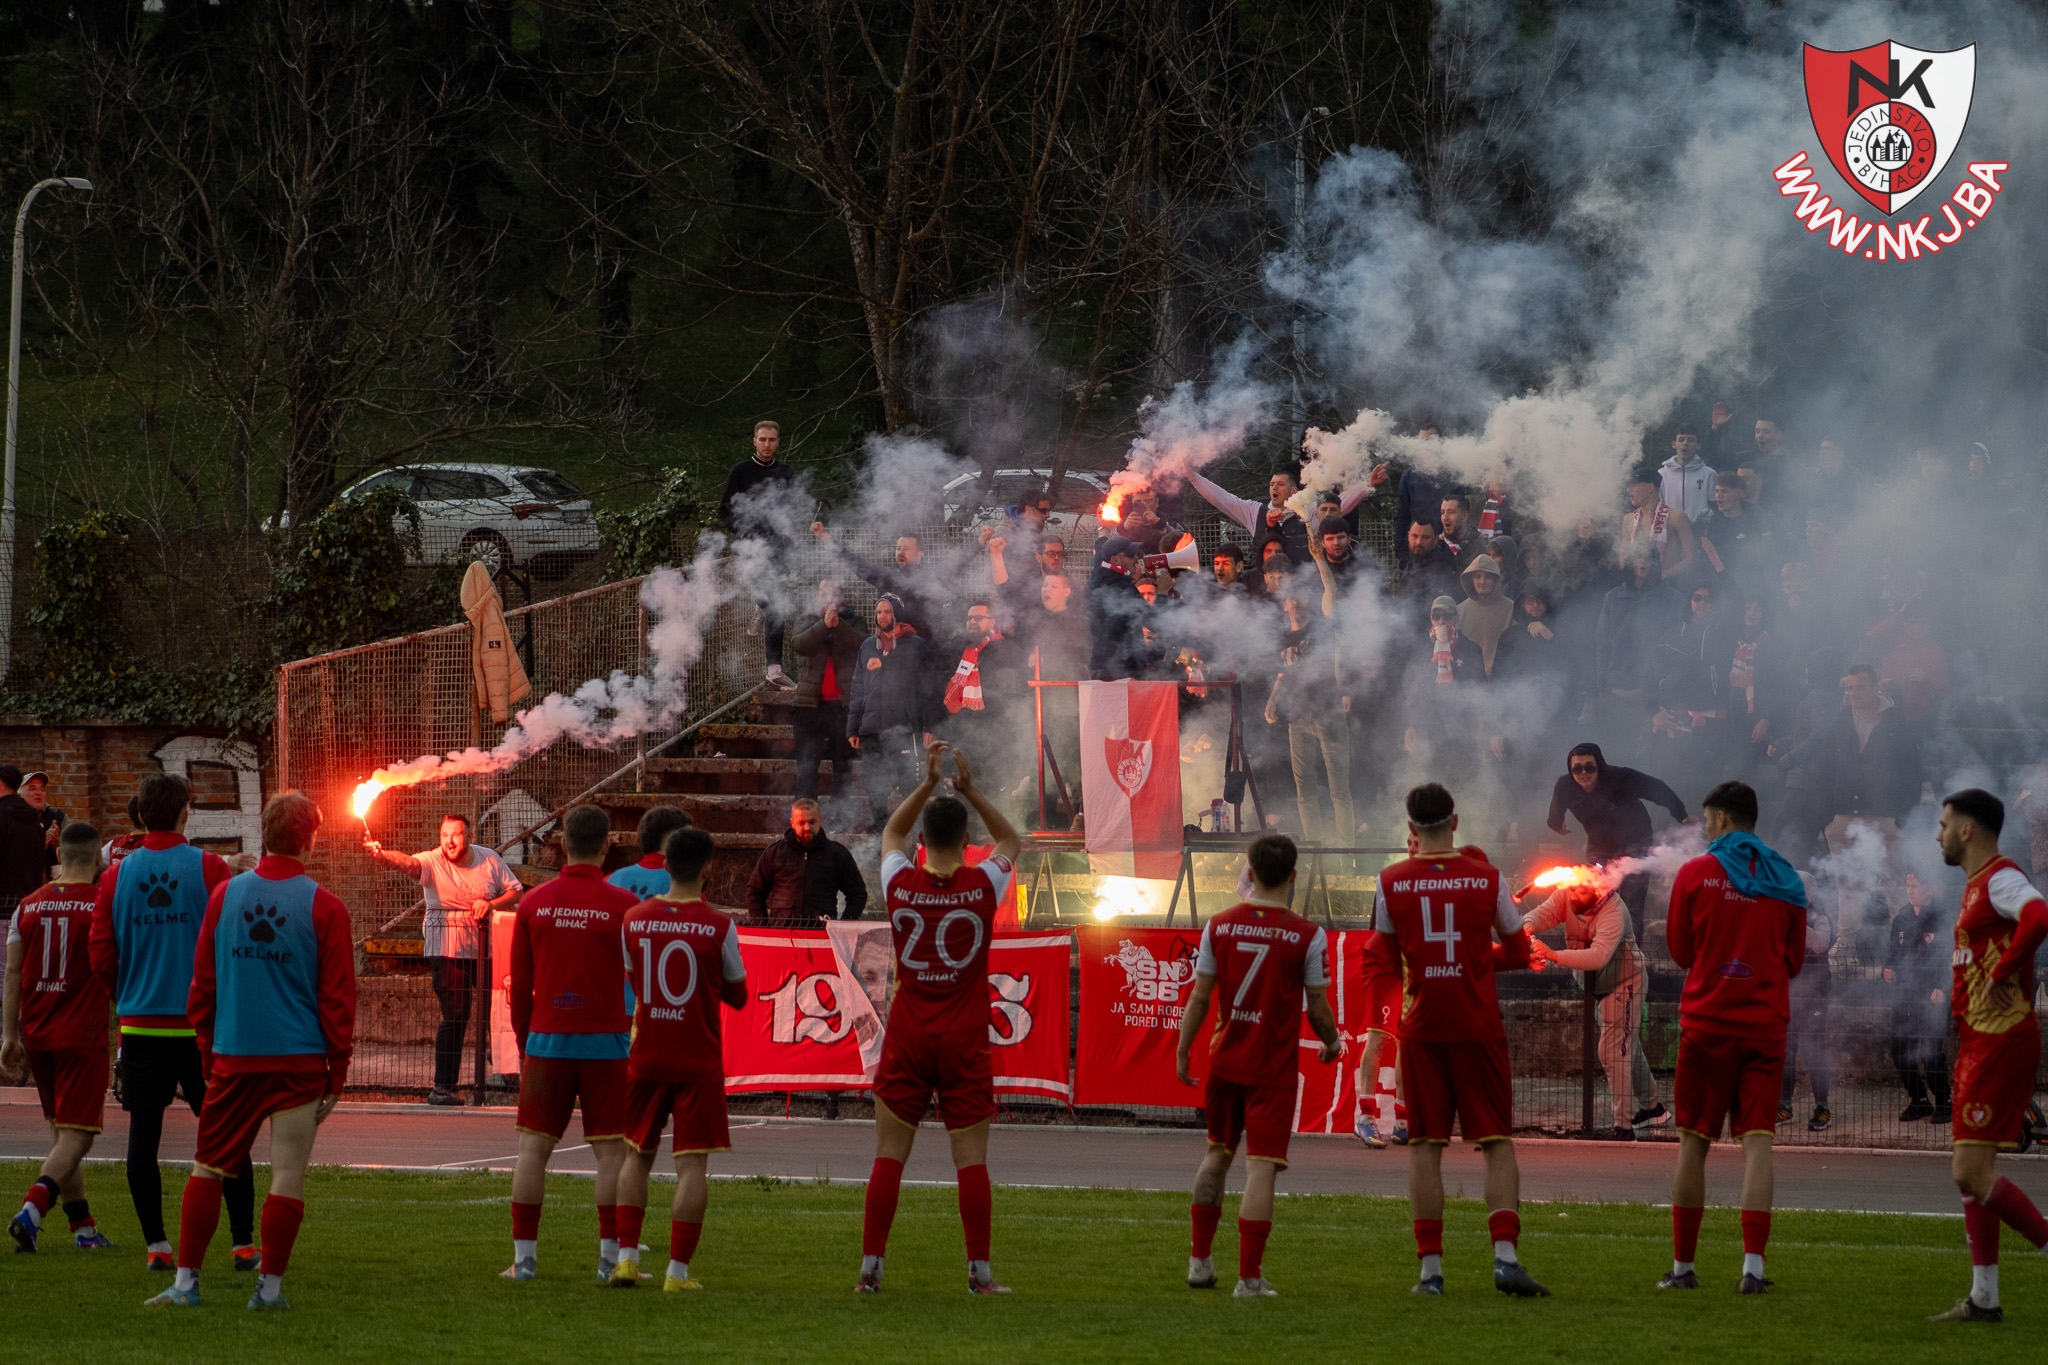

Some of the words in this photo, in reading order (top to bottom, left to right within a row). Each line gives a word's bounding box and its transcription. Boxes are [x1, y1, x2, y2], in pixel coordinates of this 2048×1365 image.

[1393, 880, 1411, 892] NK
[1413, 877, 1488, 893] JEDINSTVO
[1703, 878, 1720, 888] NK
[893, 887, 911, 902] NK
[910, 888, 983, 905] JEDINSTVO
[24, 902, 38, 914] NK
[536, 907, 550, 917] NK
[553, 907, 610, 921] JEDINSTVO
[132, 912, 189, 926] KELME
[555, 917, 588, 930] BIHAĆ
[630, 921, 646, 932] NK
[646, 921, 716, 937] JEDINSTVO
[1216, 923, 1231, 935] NK
[1231, 924, 1300, 943] JEDINSTVO
[1420, 896, 1461, 963] 4
[892, 908, 983, 969] 20
[40, 917, 69, 979] 11
[232, 946, 292, 964] KELME
[639, 938, 698, 1006] 10
[917, 968, 959, 982] BIHAĆ
[1136, 959, 1181, 981] SN
[1234, 941, 1270, 1007] 7
[1424, 963, 1463, 978] BIHAĆ
[36, 979, 67, 992] BIHAĆ
[1136, 981, 1179, 1002] 96
[650, 1006, 685, 1021] BIHAĆ
[1110, 1002, 1125, 1014] JA
[1130, 1003, 1154, 1015] SAM
[1125, 1015, 1158, 1028] PORED
[1231, 1009, 1262, 1024] BIHAĆ
